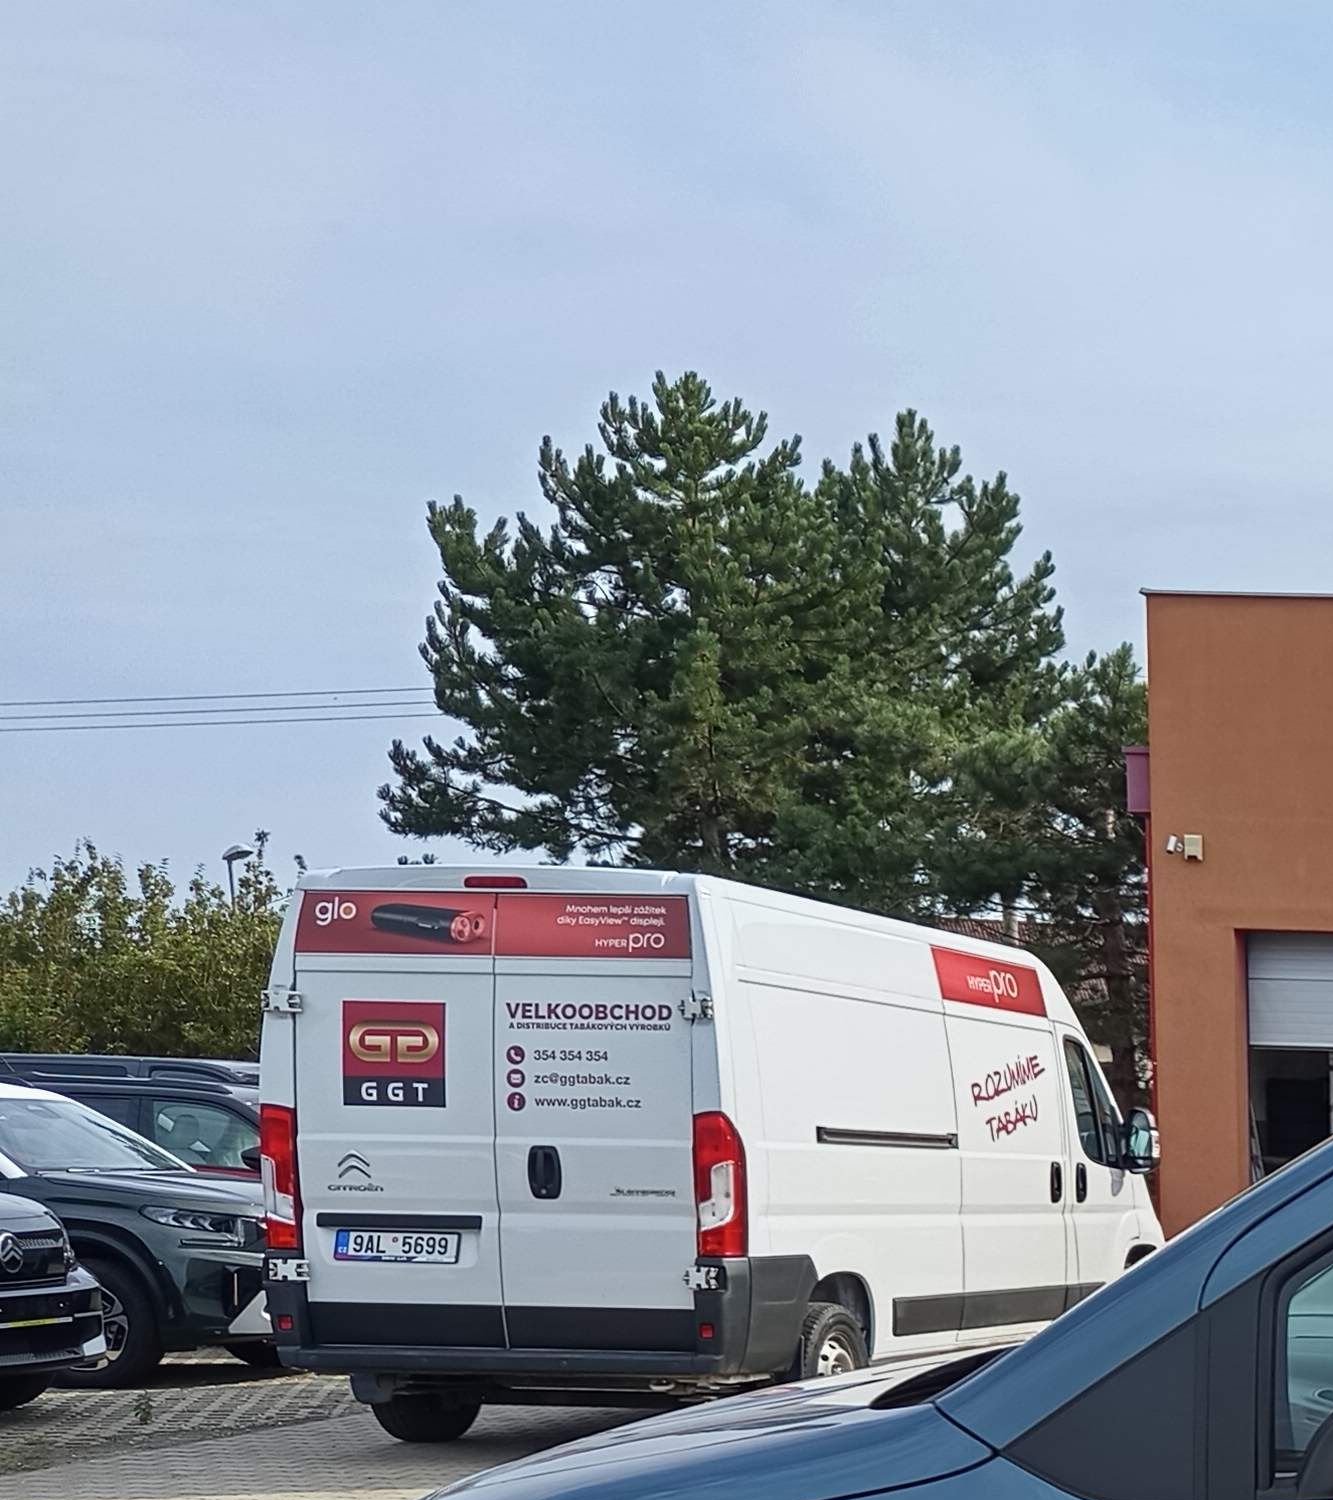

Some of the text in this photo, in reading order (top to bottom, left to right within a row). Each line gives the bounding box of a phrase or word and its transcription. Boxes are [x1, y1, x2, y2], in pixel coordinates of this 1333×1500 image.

[315, 896, 357, 926] glo
[565, 904, 608, 914] Mnohem
[609, 904, 632, 916] lepší
[628, 932, 666, 953] pro
[506, 1002, 673, 1021] VELKOOBCHOD
[508, 1021, 672, 1032] A DISTRIBUCE TABÁKOVÝCH VÝROBKŮ
[533, 1050, 609, 1062] 354 354 354
[533, 1072, 631, 1087] zc@ggtabak.cz
[971, 1055, 1046, 1107] ROZUMÍME
[534, 1096, 642, 1110] www.ggtabak.cz
[985, 1094, 1039, 1142] TABÁKU
[352, 1234, 449, 1256] 9AL 5699
